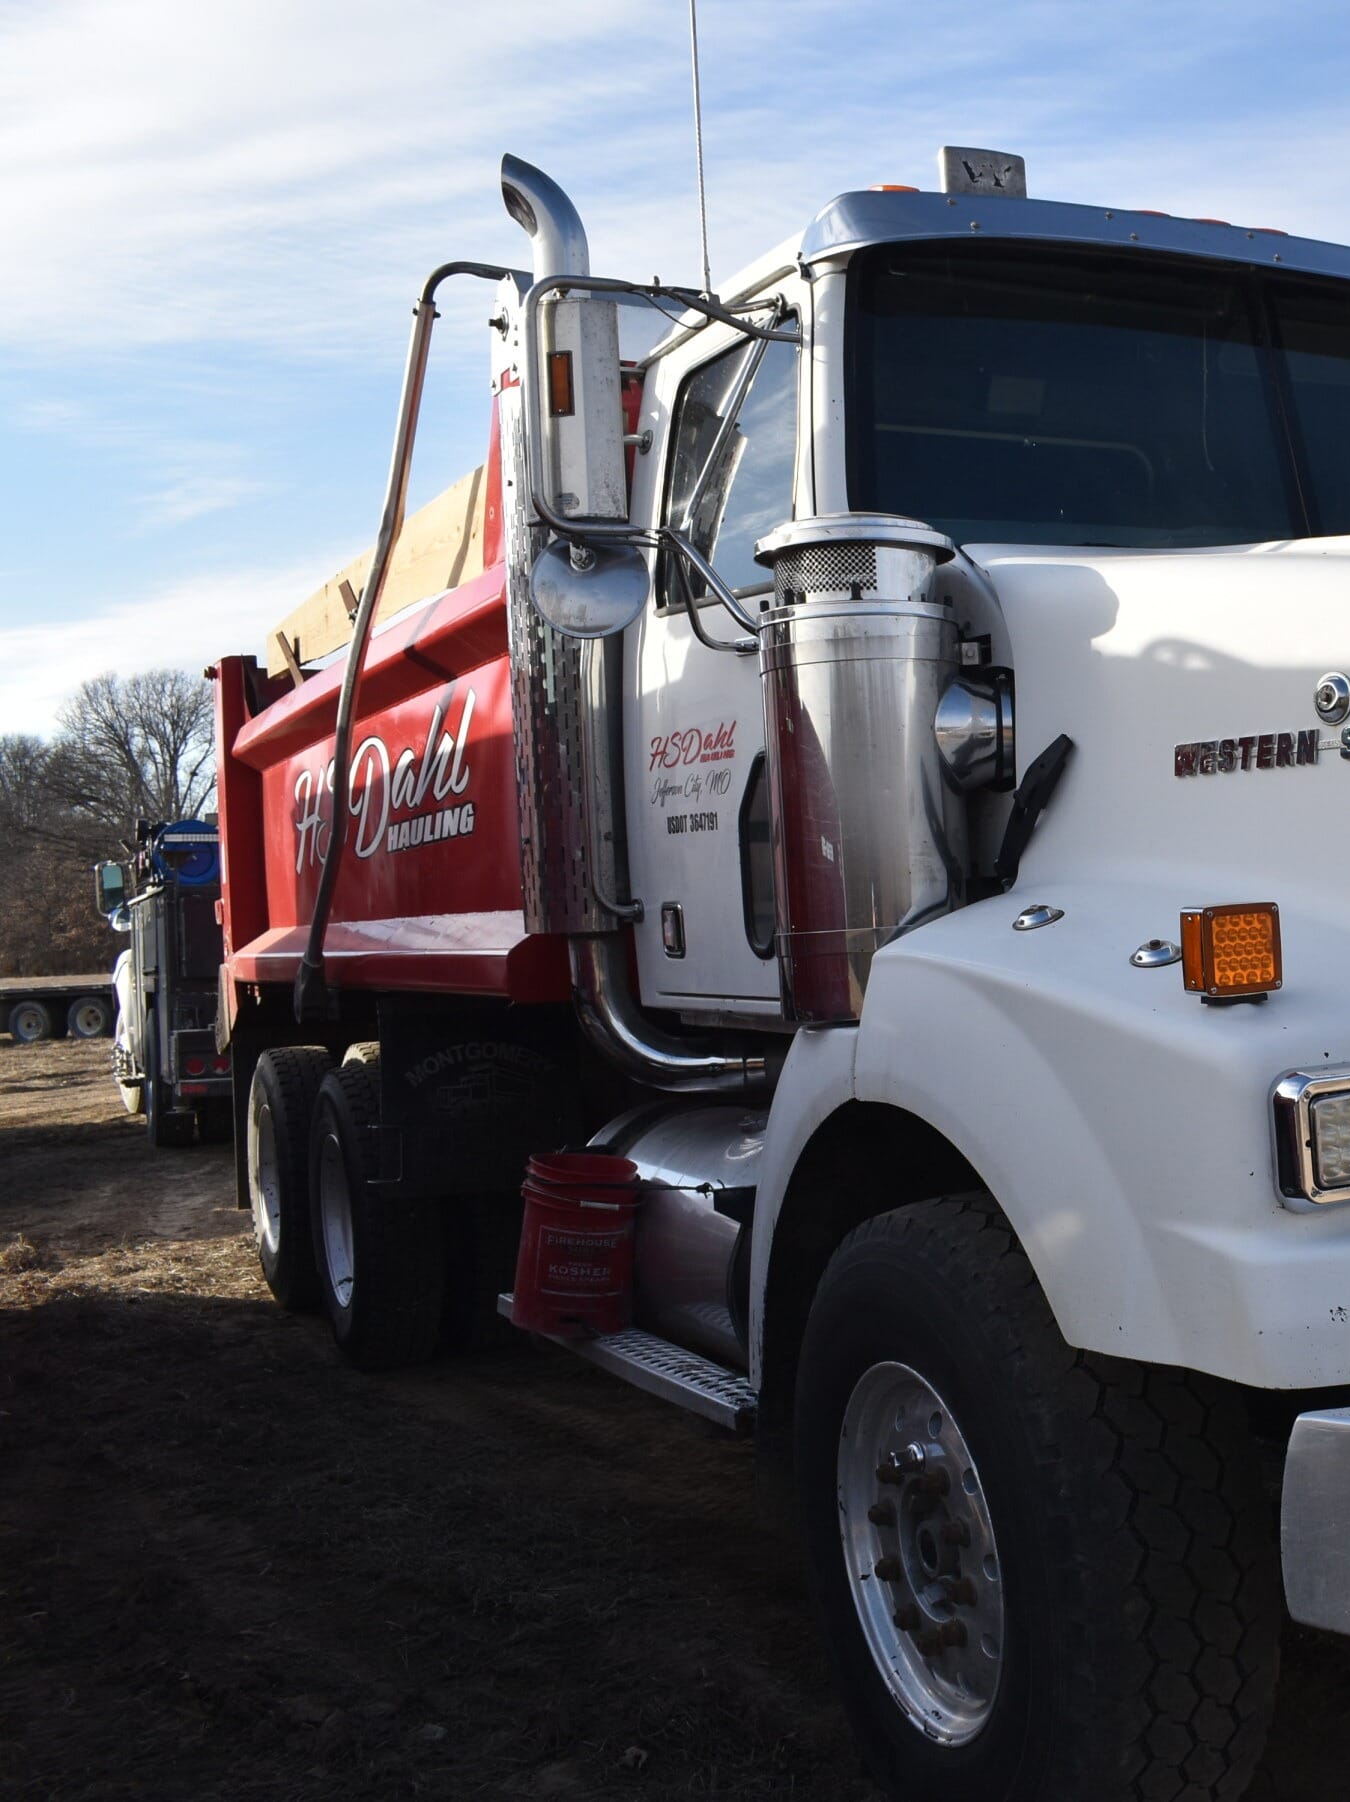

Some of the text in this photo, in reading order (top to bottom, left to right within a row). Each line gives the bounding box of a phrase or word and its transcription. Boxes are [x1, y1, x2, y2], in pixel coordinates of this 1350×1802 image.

[1174, 728, 1320, 778] WESTERN
[387, 803, 477, 853] HAULING
[667, 811, 719, 834] USDOT 3647191
